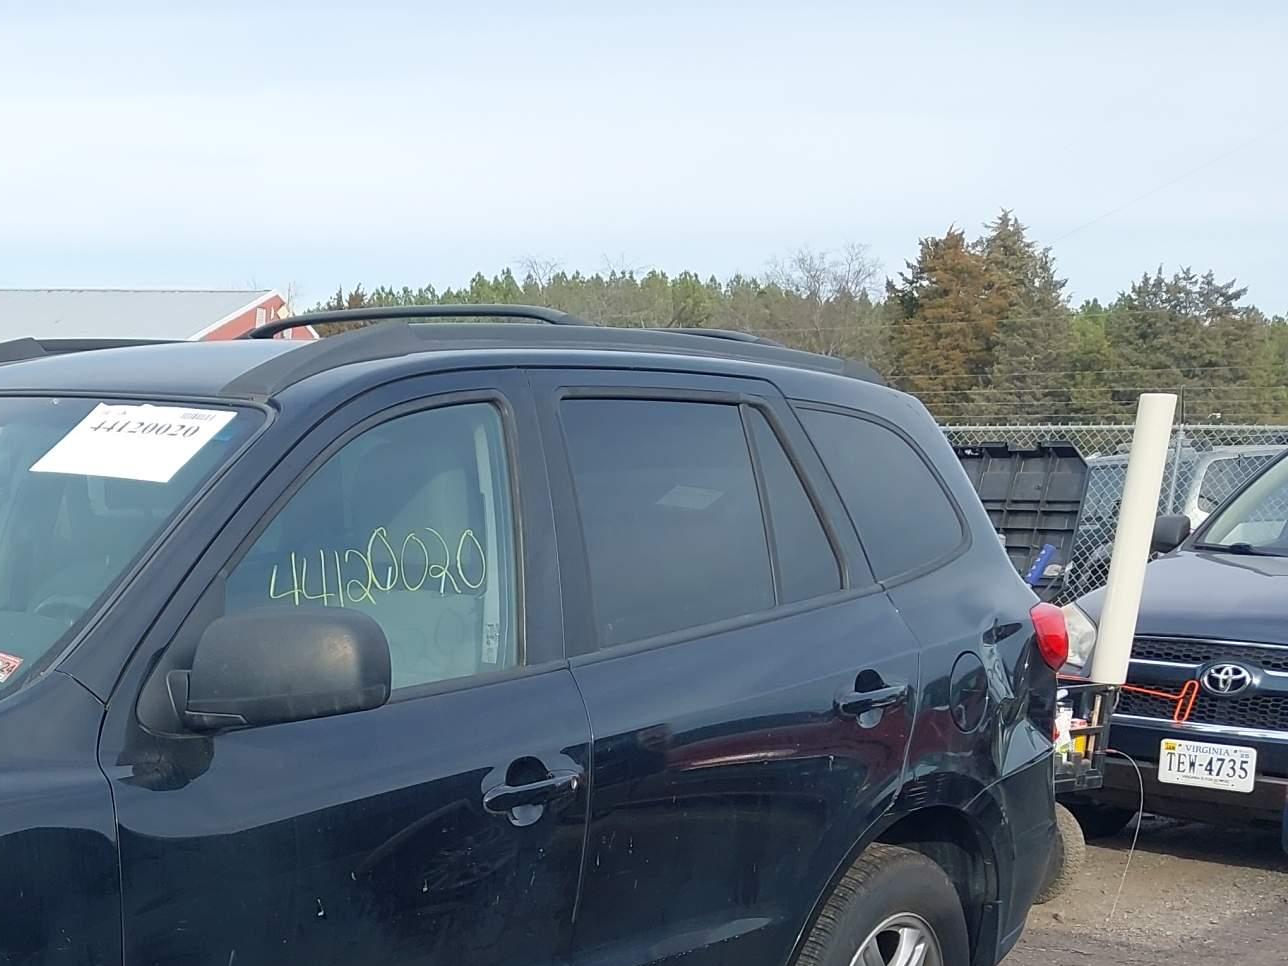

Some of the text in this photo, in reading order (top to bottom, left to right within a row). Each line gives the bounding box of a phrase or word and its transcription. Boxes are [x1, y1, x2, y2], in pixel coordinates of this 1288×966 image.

[91, 420, 201, 438] 44120020
[270, 526, 486, 608] 44120020
[1185, 744, 1230, 756] VIRGINIA
[1166, 752, 1249, 779] TEW-4735
